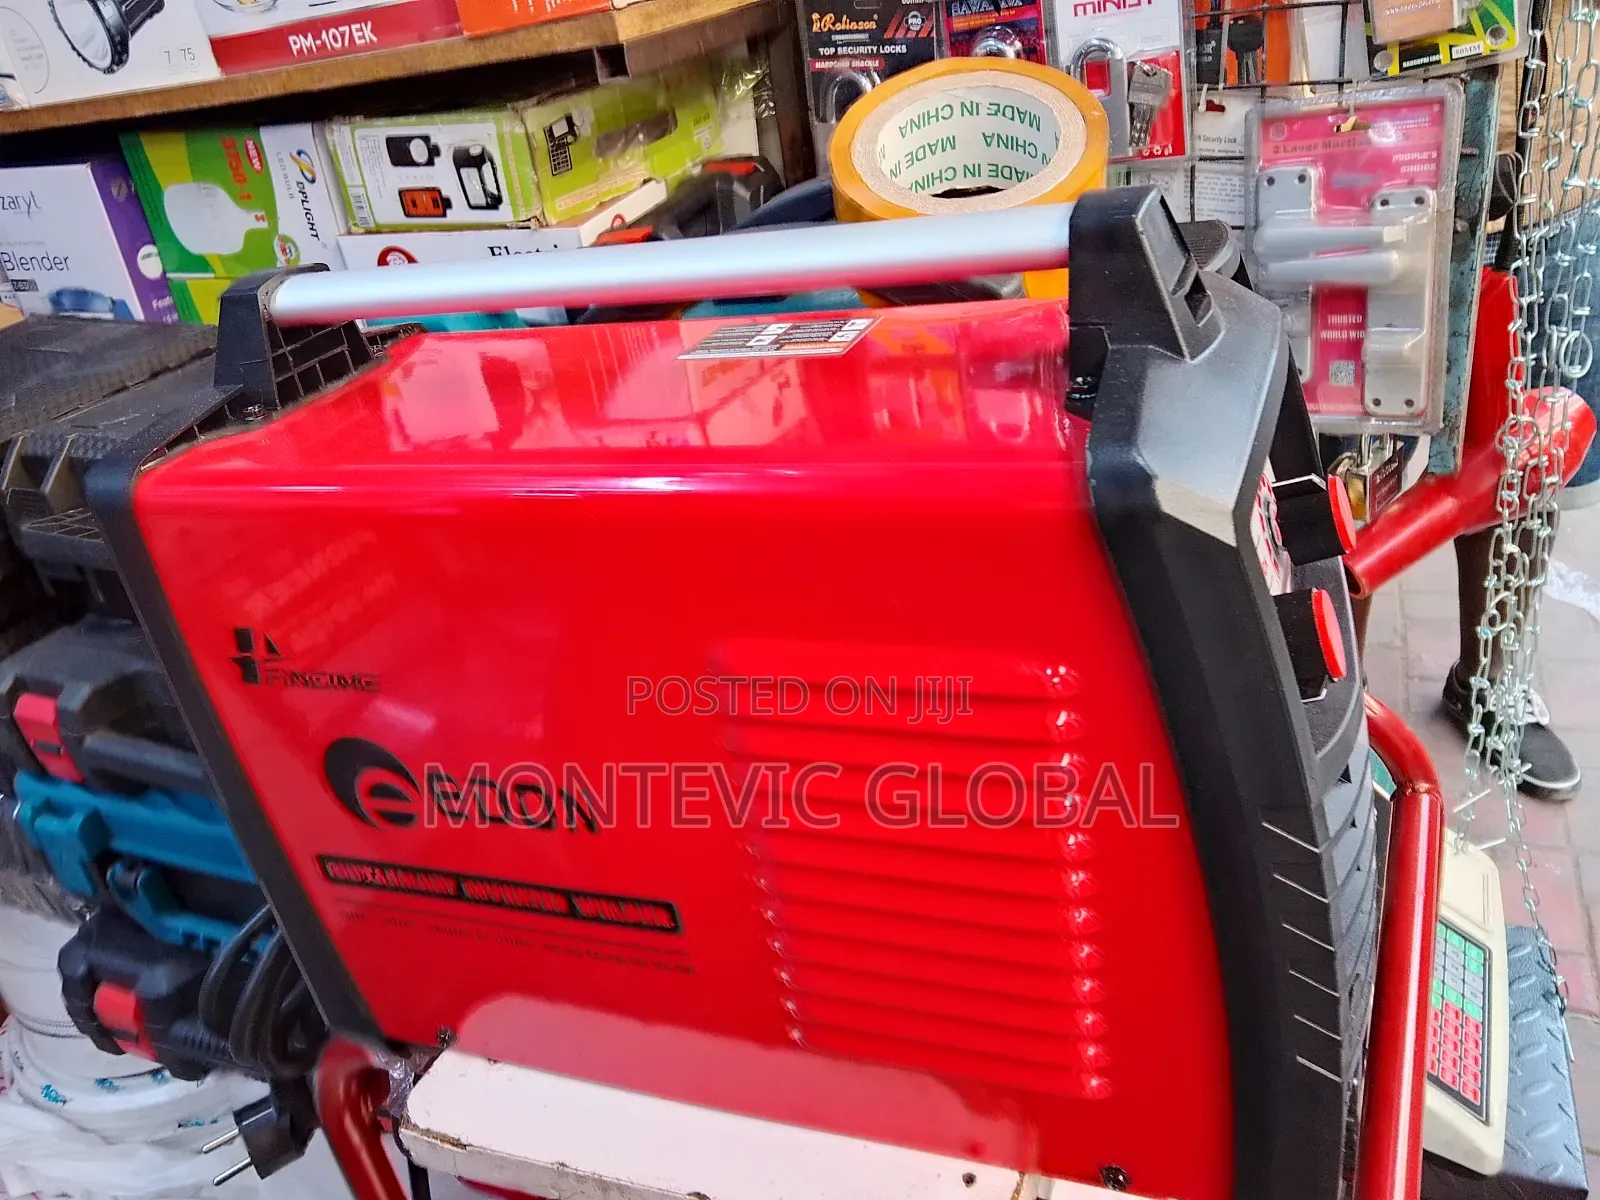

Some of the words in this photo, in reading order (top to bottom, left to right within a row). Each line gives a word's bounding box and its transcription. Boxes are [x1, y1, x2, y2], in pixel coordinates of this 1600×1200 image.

[288, 20, 378, 57] PM-107EK
[819, 47, 836, 56] TOP
[837, 45, 878, 55] SECURITY
[879, 44, 908, 54] LOCKS
[898, 103, 955, 140] CHINA
[960, 100, 980, 118] IN
[987, 102, 1042, 133] MADE
[904, 134, 957, 171] MADE
[982, 131, 1039, 160] CHINA
[1202, 135, 1223, 145] Security
[245, 138, 263, 172] NEW
[889, 160, 903, 180] IN
[963, 163, 983, 179] IN
[296, 180, 321, 241] DPLIGHT
[0, 250, 70, 272] Blender
